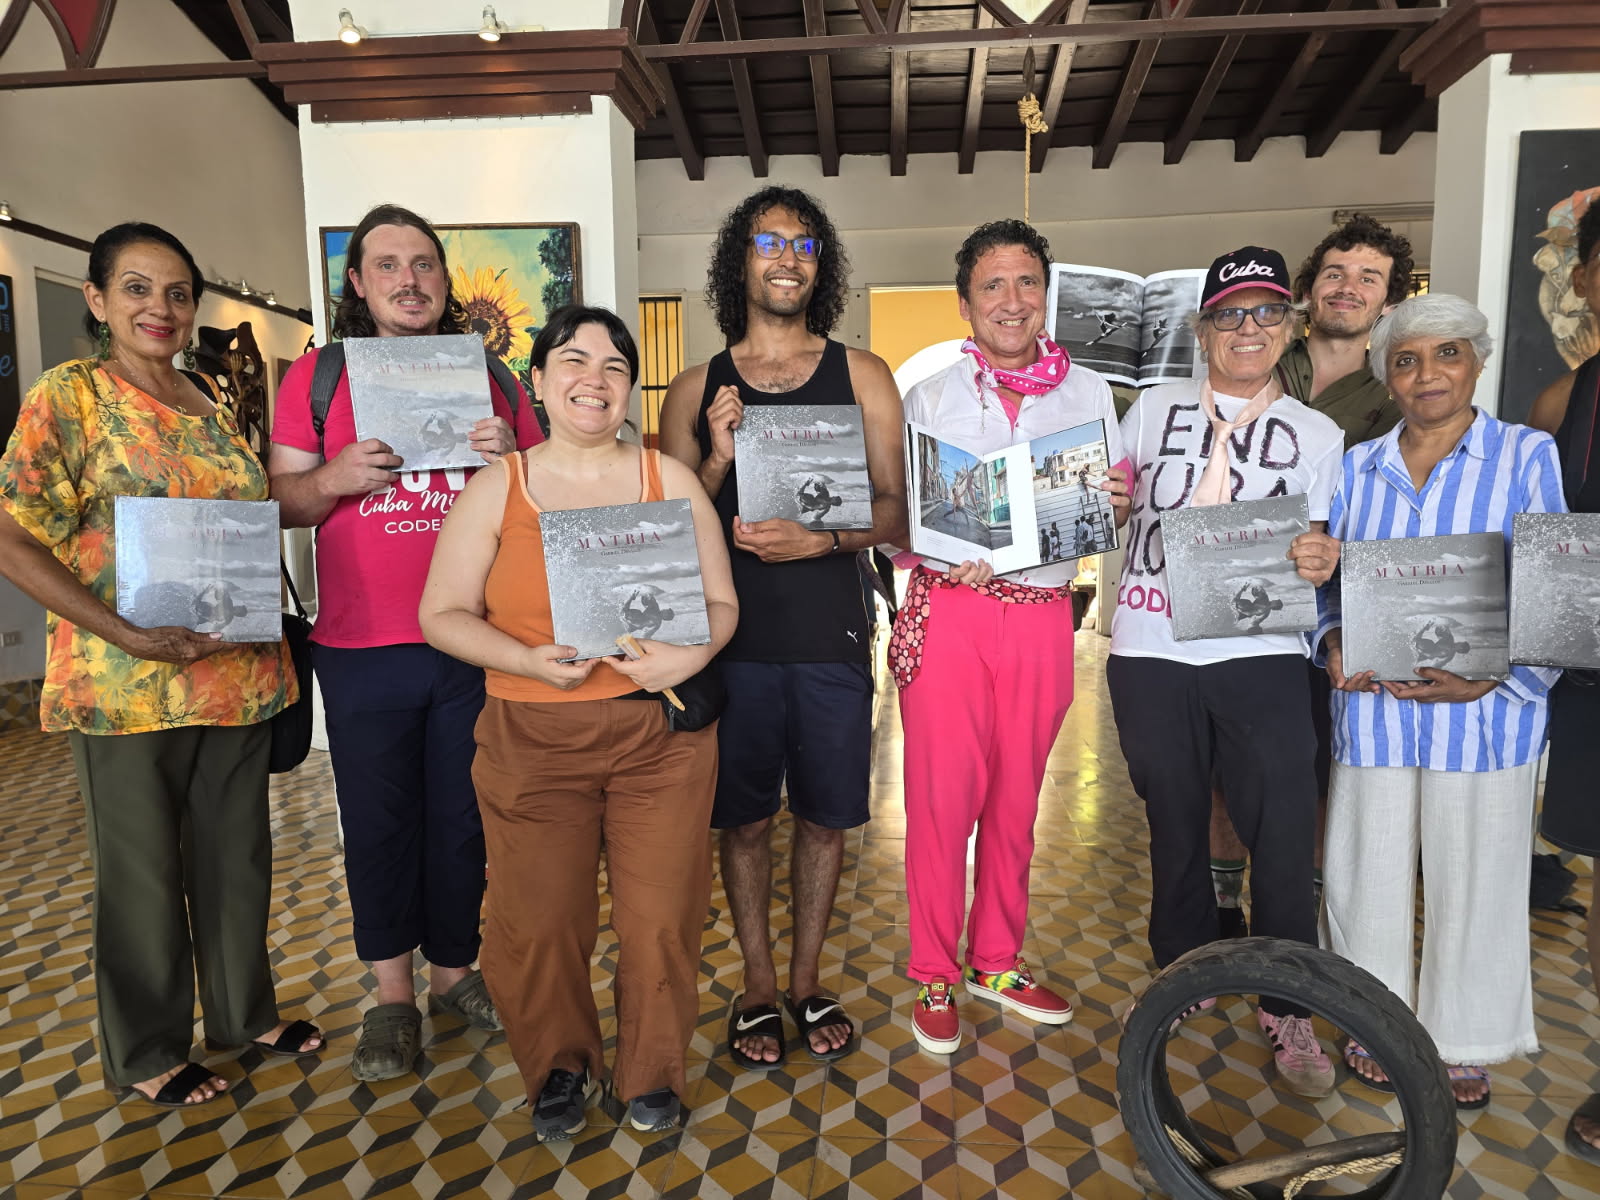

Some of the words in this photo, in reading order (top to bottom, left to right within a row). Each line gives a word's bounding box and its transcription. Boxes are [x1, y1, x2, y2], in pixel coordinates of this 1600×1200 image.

[1219, 260, 1275, 282] Cuba
[763, 429, 834, 440] MATRIA
[1158, 402, 1301, 470] END
[359, 487, 414, 517] Cuba
[384, 518, 446, 535] CODE
[577, 530, 662, 549] MATRIA
[1193, 527, 1275, 545] MATRIA
[1375, 563, 1465, 578] MATRIA
